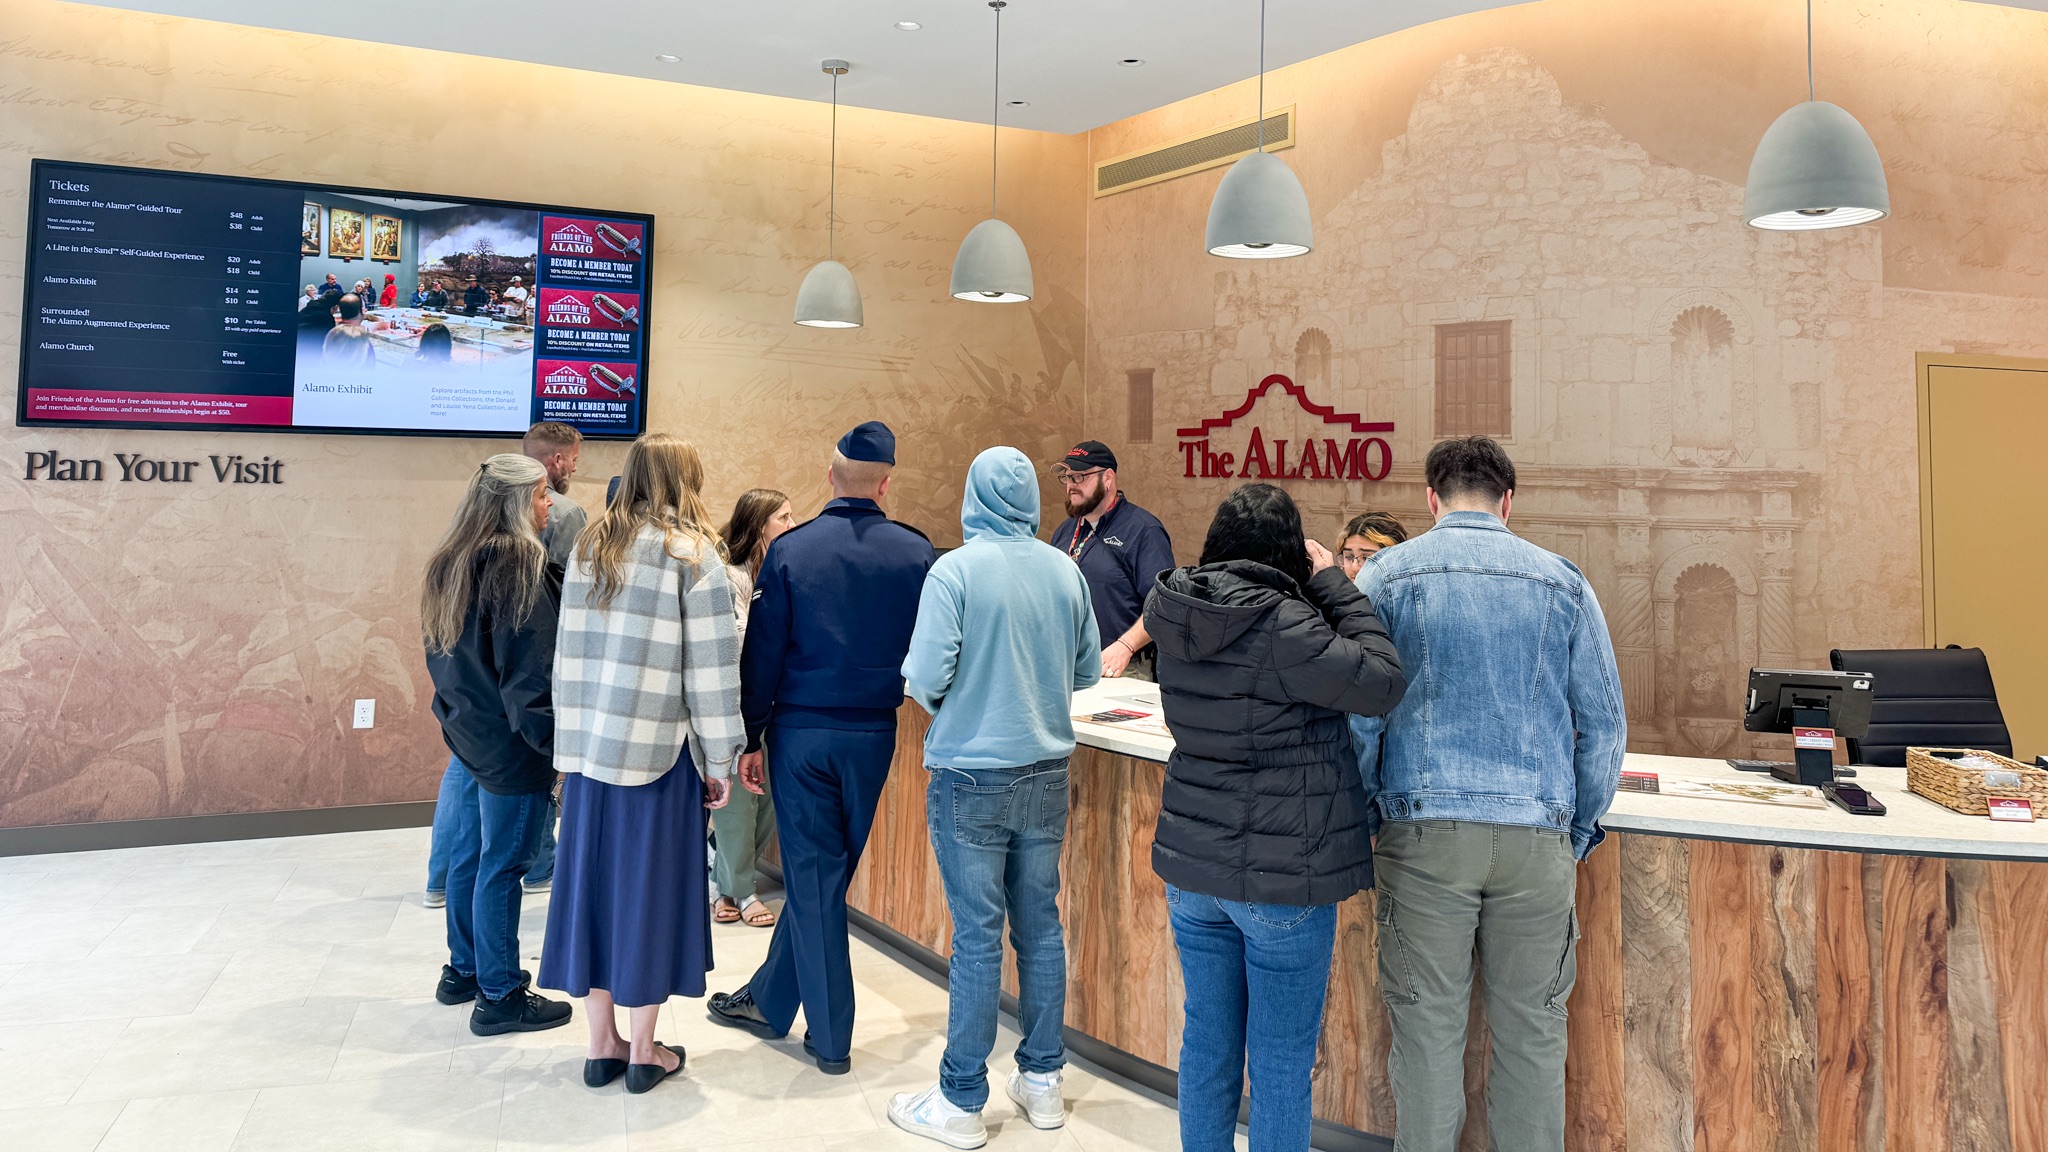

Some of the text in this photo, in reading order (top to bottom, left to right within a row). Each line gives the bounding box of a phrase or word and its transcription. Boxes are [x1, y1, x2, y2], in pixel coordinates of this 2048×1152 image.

[49, 180, 90, 192] Tickets
[48, 197, 91, 207] Remember
[137, 204, 164, 213] Guided
[165, 206, 183, 214] Tour
[230, 211, 243, 219] $48
[229, 222, 242, 230] $38
[551, 233, 573, 241] FRIENDS
[582, 235, 592, 244] THE
[53, 244, 70, 252] Line
[80, 246, 93, 254] the
[120, 248, 163, 258] Self-Guided
[164, 251, 205, 261] Experience
[549, 243, 594, 254] ALAMO
[550, 258, 633, 272] BECOME A MEMBER TODAY
[43, 276, 97, 286] Alamo Exhibit
[41, 307, 90, 316] Surrounded!
[548, 304, 571, 312] FRIENDS
[579, 306, 590, 314] THE
[41, 316, 170, 330] The Alamo Augmented Experience
[224, 316, 239, 324] $10
[546, 314, 591, 325] ALAMO
[547, 329, 630, 342] BECOME A MEMBER TODAY
[39, 342, 94, 351] Alamo Church
[545, 376, 568, 384] FRIENDS
[576, 377, 587, 385] THE
[302, 383, 373, 395] Alamo Exhibit
[543, 385, 588, 395] ALAMO
[51, 395, 74, 403] Friends
[141, 398, 171, 406] admission
[544, 400, 627, 412] BECOME A MEMBER TODAY
[89, 405, 119, 413] discounts,
[152, 407, 193, 415] Memberships
[1179, 426, 1393, 481] The ALAMO
[23, 450, 284, 484] Plan Your Visit
